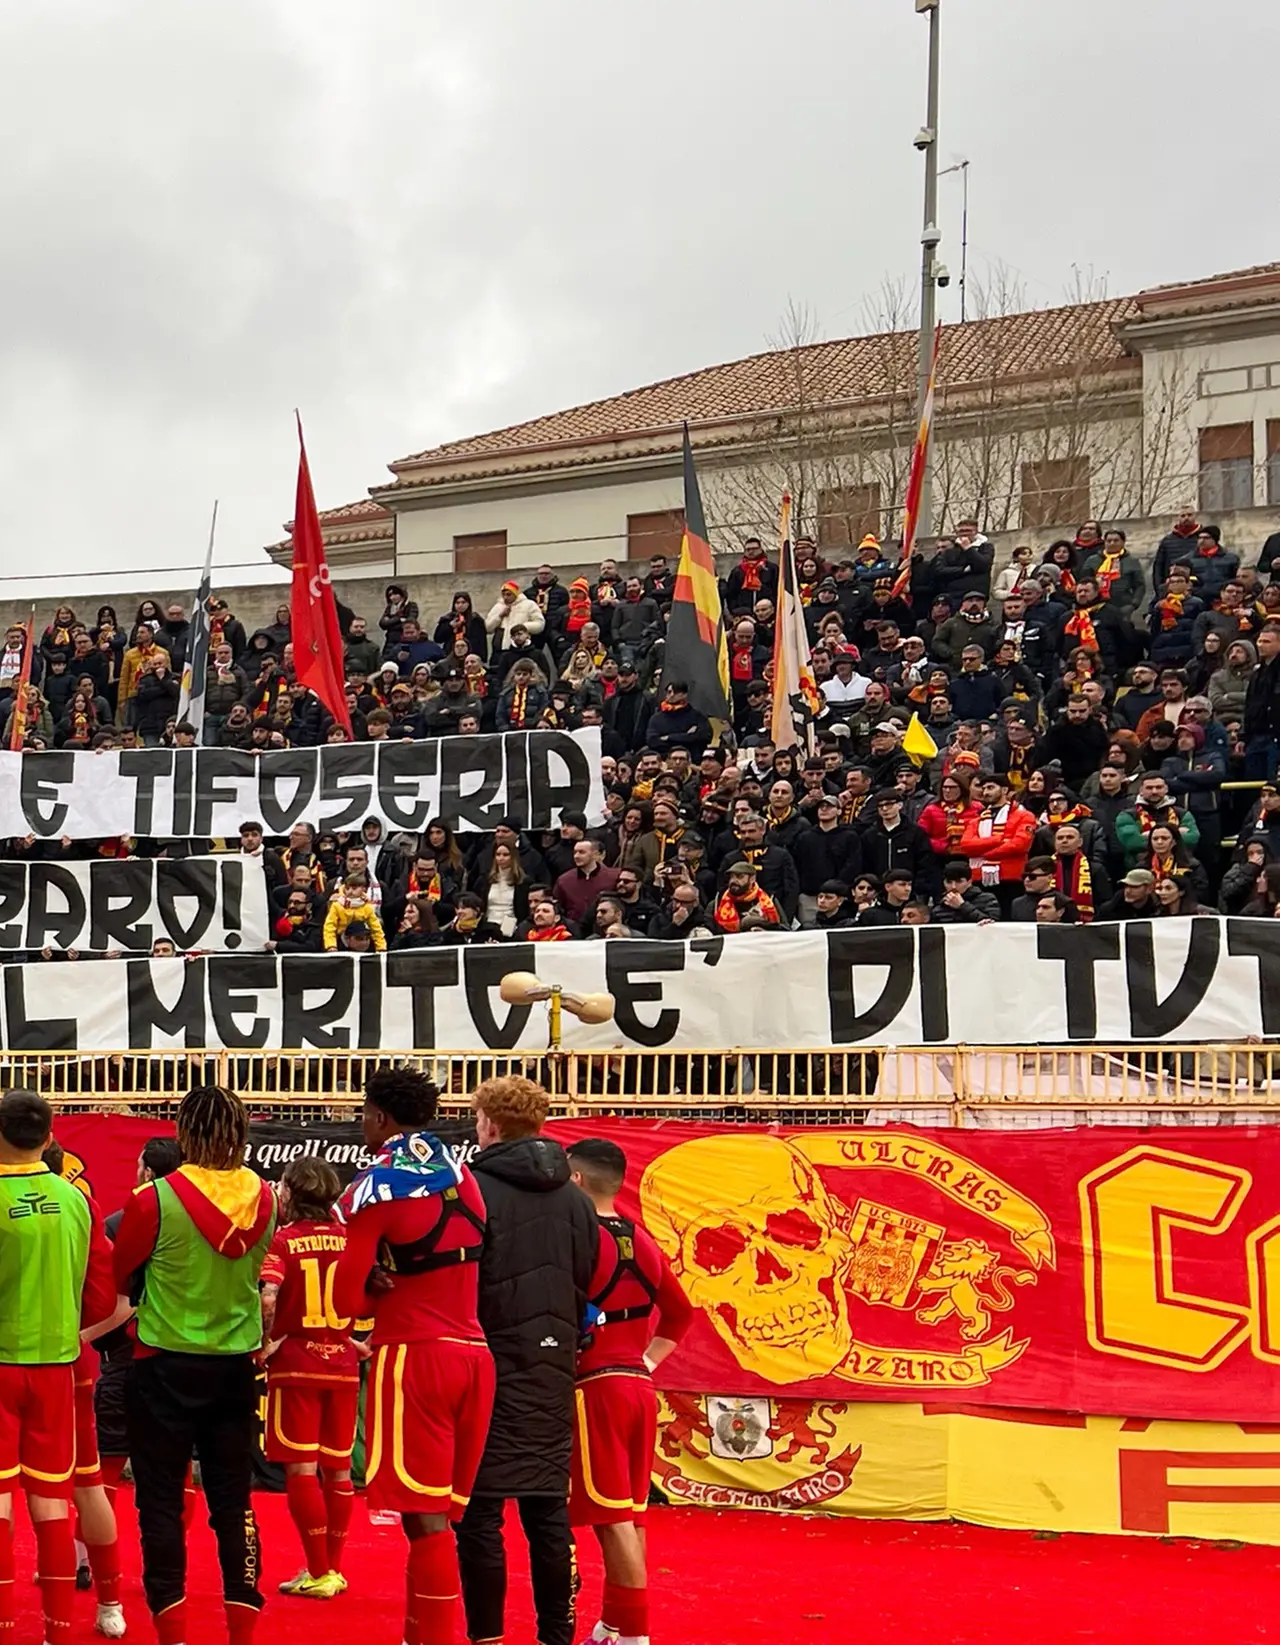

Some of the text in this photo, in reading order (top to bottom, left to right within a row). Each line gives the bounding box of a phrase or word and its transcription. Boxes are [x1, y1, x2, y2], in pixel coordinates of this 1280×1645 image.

[20, 751, 75, 837] E
[119, 729, 592, 837] TIFOSERIA
[127, 944, 536, 1051] MERITO
[827, 926, 949, 1045] DI
[836, 1139, 1008, 1212] ULTRAS
